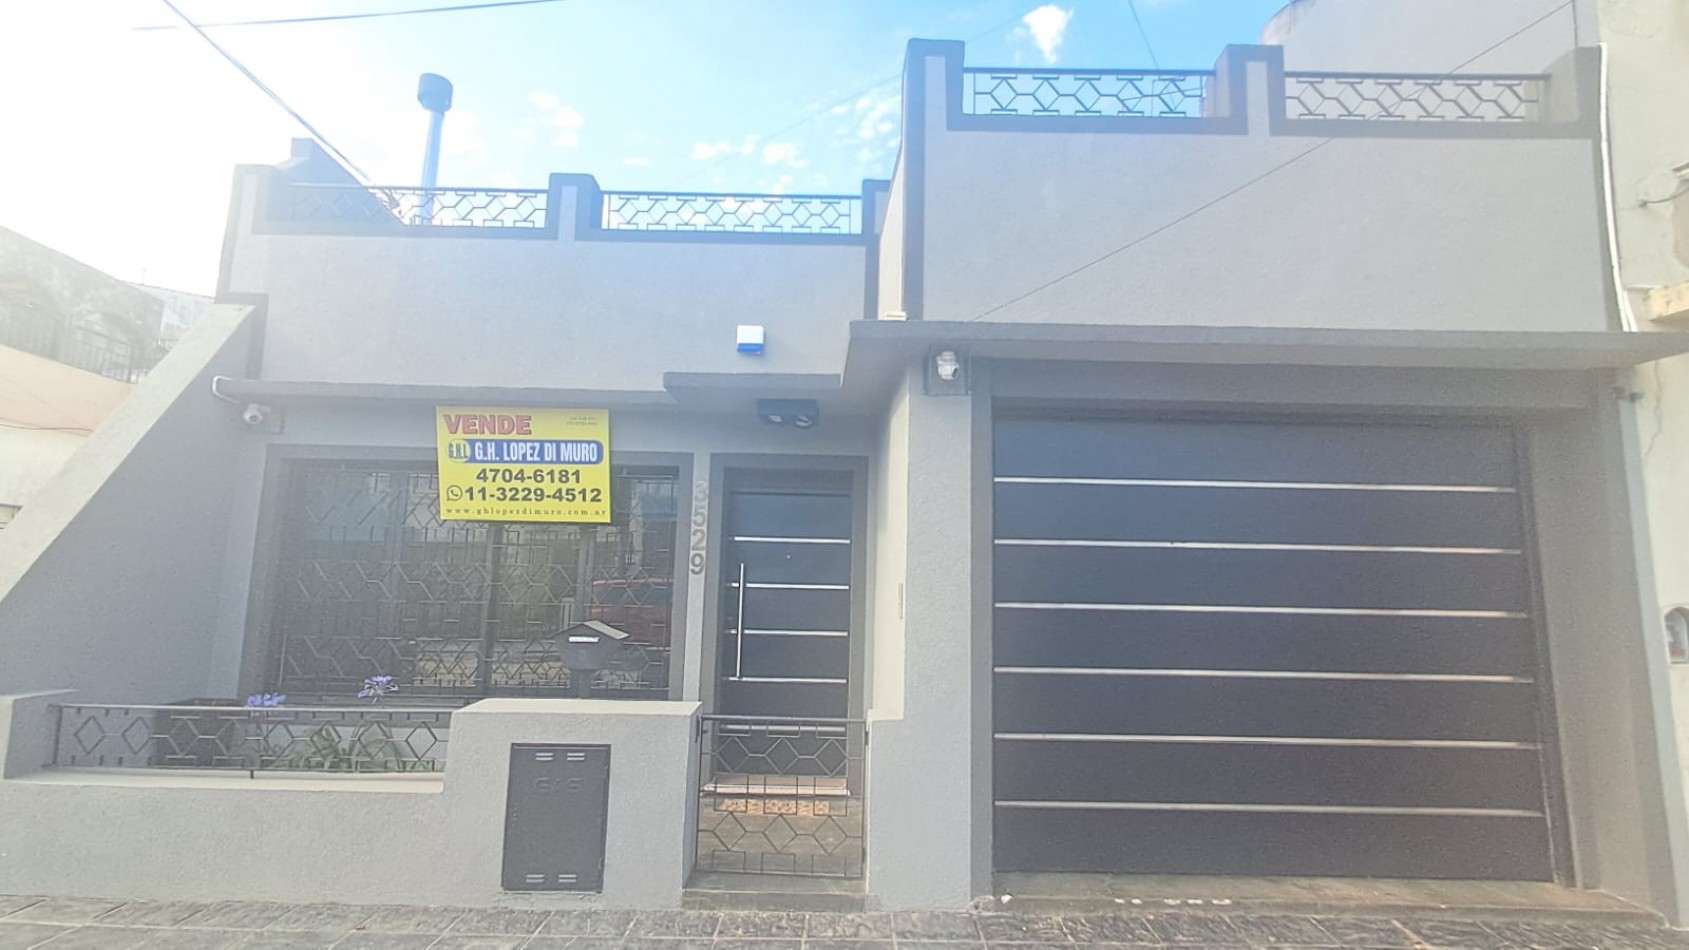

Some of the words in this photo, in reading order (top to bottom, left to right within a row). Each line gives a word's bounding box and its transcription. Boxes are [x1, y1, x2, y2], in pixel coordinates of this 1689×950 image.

[443, 414, 532, 436] VENDE
[475, 442, 500, 461] G.H.
[503, 442, 540, 462] LOPEZ
[544, 442, 557, 462] DI
[560, 443, 598, 463] MURO
[476, 468, 581, 485] 4704-6181
[465, 486, 602, 503] 11-3229-4512
[690, 480, 708, 576] 3529
